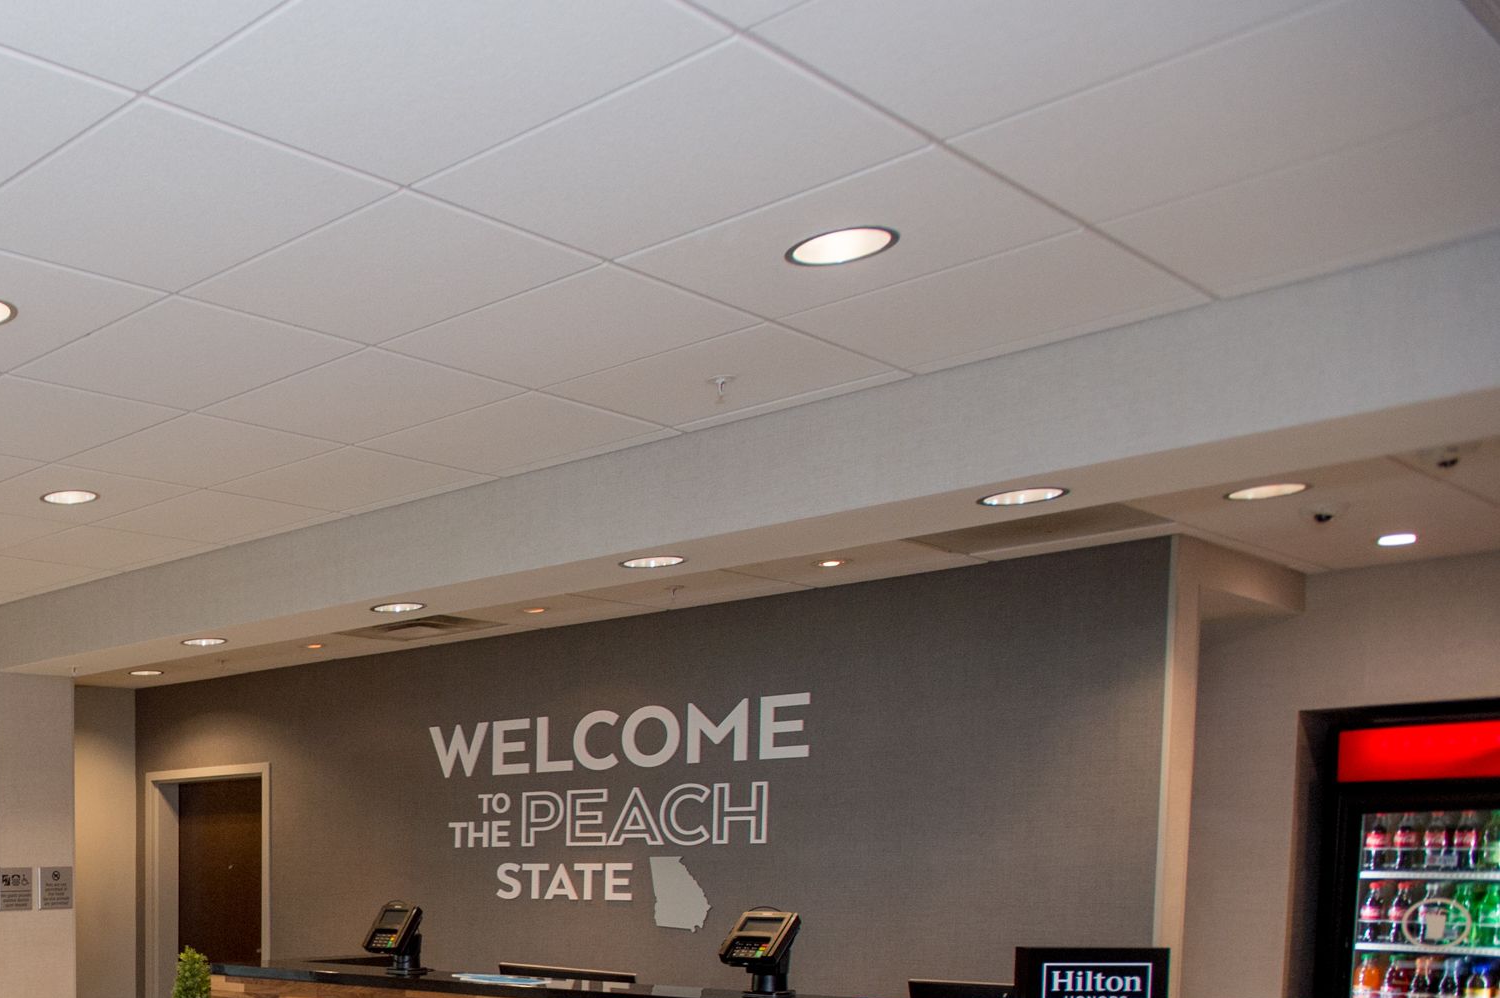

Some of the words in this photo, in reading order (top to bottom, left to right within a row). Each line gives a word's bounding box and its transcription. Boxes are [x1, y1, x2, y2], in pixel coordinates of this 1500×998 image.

[428, 692, 811, 778] WELCOME
[478, 793, 510, 814] TO
[521, 781, 769, 847] PEACH
[448, 820, 511, 848] THE
[496, 862, 633, 901] STATE
[1051, 969, 1143, 993] Hilton
